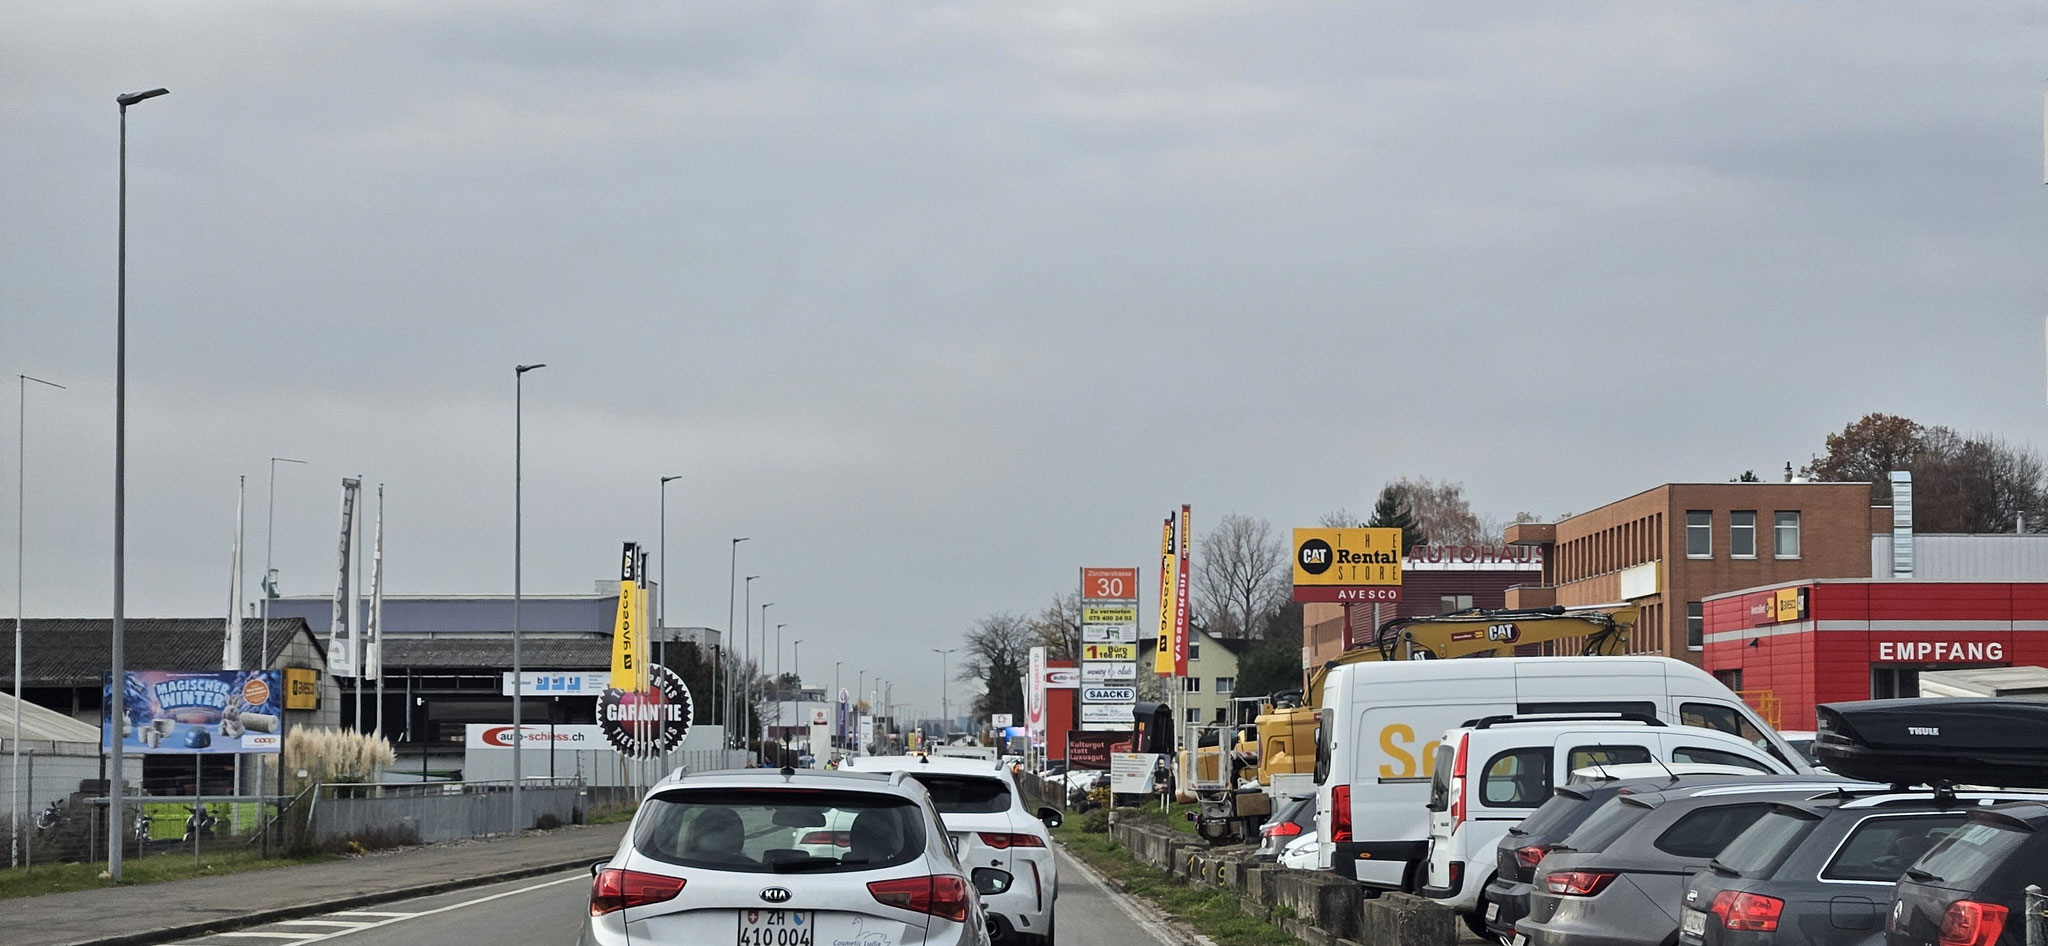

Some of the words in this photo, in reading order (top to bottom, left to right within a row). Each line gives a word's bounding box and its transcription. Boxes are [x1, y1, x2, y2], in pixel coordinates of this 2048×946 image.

[1337, 533, 1397, 548] THE
[1303, 549, 1327, 564] CAT
[1337, 549, 1398, 564] Rental
[1338, 565, 1398, 580] STORE
[1097, 577, 1123, 597] 30
[1338, 590, 1397, 599] AVESCO
[1488, 623, 1513, 641] CAT
[1087, 645, 1098, 659] 1
[1107, 645, 1128, 653] Büro
[1880, 642, 2003, 660] EMPFANG
[156, 679, 230, 695] MAGISCHER
[1089, 690, 1130, 698] SAACKE
[159, 690, 226, 708] WINTER
[606, 703, 682, 721] GARANTIE
[500, 732, 585, 741] auo-schiess.ch
[1908, 727, 1939, 736] THULE
[765, 889, 786, 899] KIA
[767, 911, 785, 925] ZH
[741, 927, 773, 946] 410
[778, 928, 810, 946] 004
